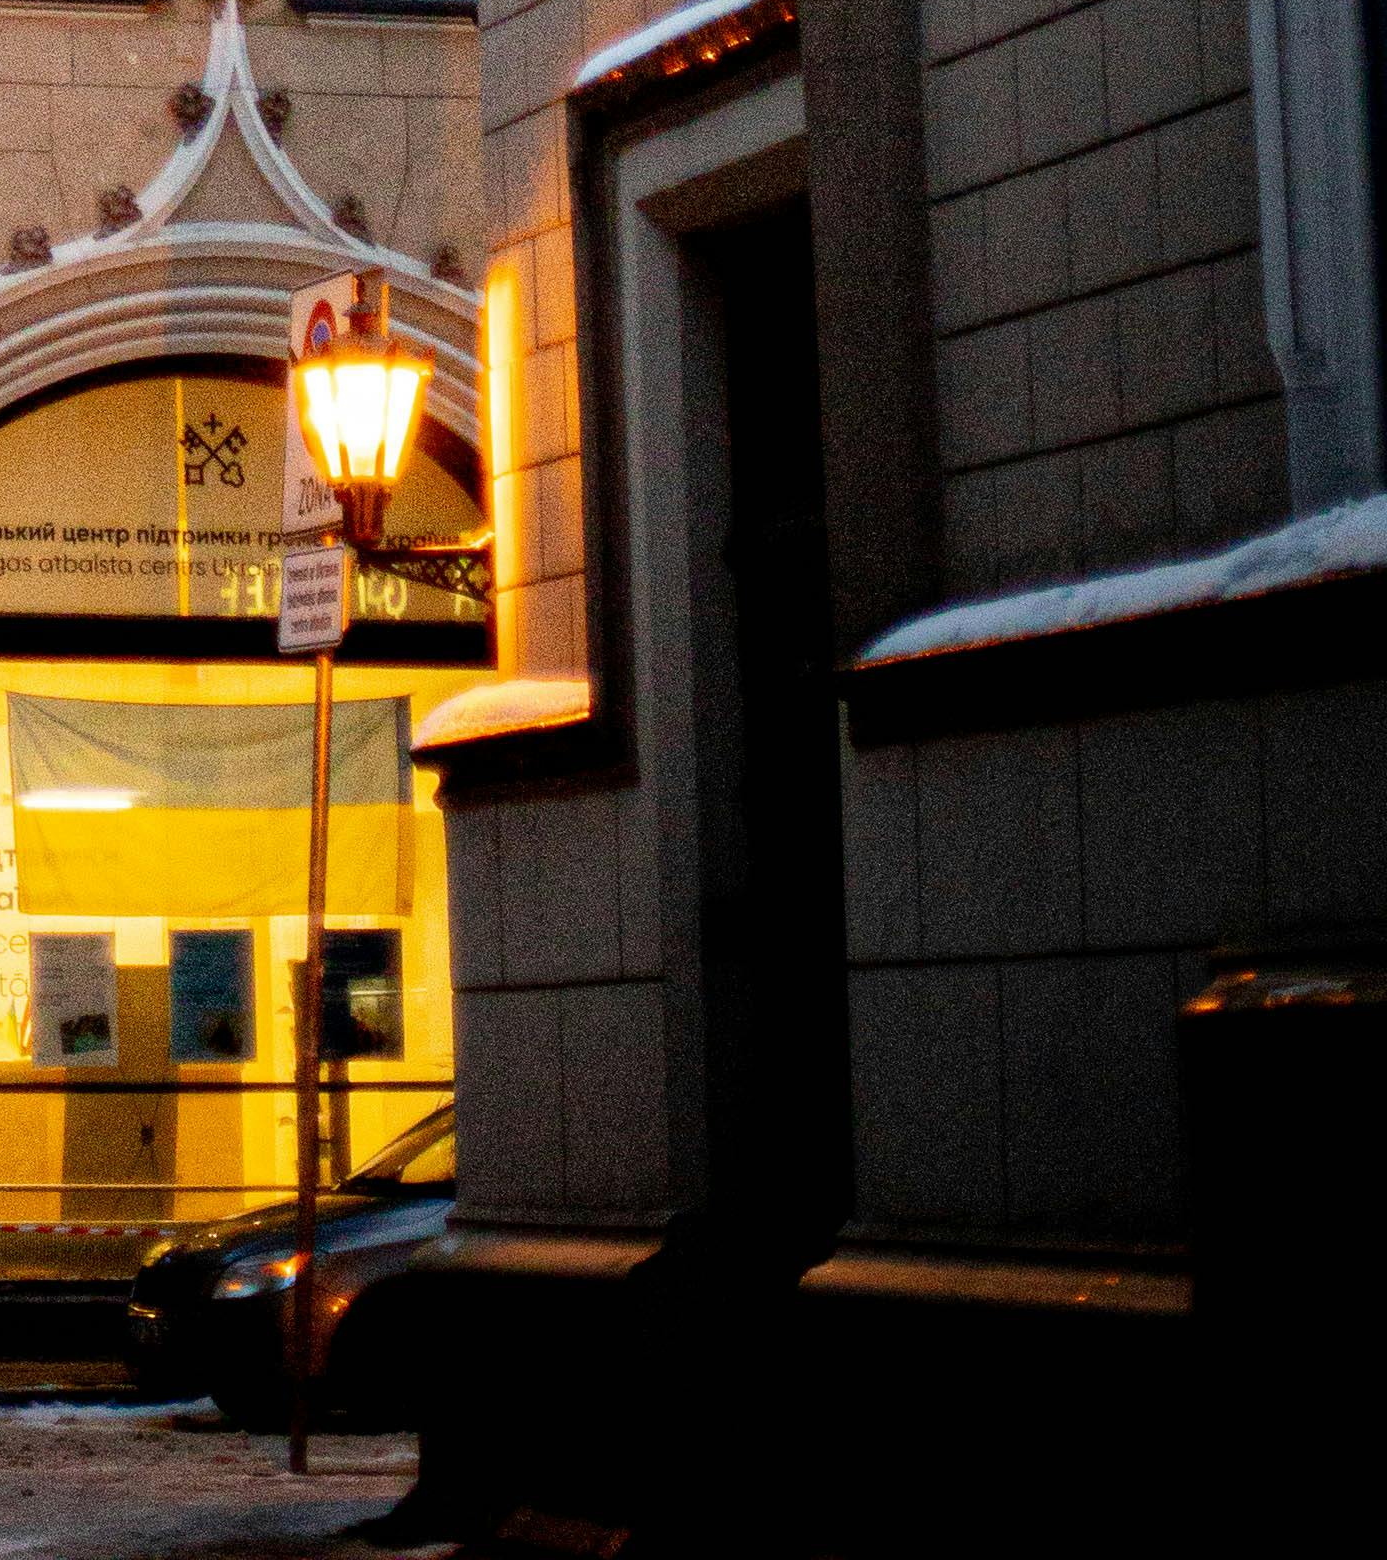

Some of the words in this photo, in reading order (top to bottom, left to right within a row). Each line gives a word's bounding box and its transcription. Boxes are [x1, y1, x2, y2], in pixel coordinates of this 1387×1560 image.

[63, 526, 130, 548] центр
[137, 524, 251, 549] підтримки
[38, 553, 132, 575] atbalsta
[139, 557, 206, 576] centrs
